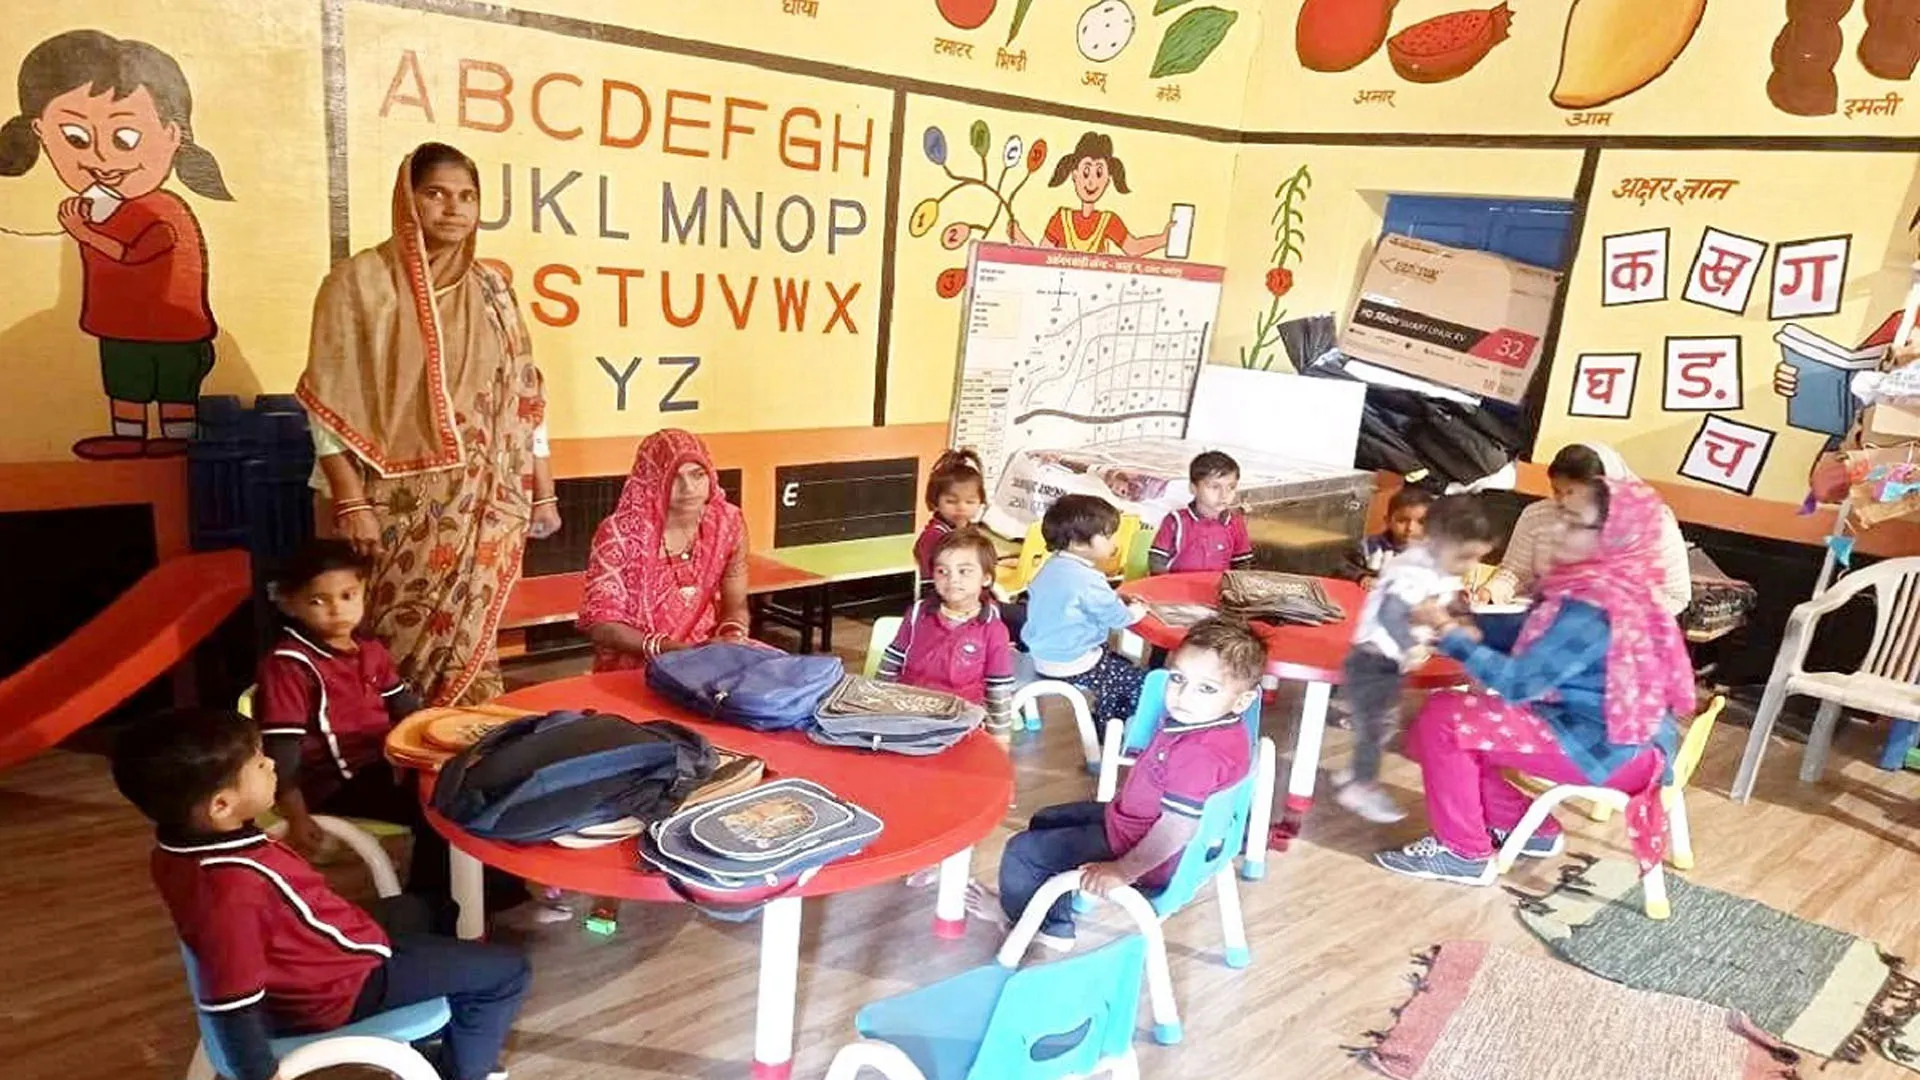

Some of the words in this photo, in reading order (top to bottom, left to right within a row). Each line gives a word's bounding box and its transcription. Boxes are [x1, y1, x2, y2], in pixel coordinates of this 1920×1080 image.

[934, 37, 975, 59] टमाटर
[1353, 89, 1396, 108] अनार
[1844, 92, 1904, 120] इमली
[1565, 112, 1613, 127] आम
[1006, 145, 1018, 160] C
[1612, 178, 1677, 206] अक्षर
[1673, 179, 1739, 205] ज्ञान
[948, 229, 958, 243] 2
[945, 275, 956, 291] 3
[1610, 249, 1659, 292] क
[1698, 245, 1752, 297] ख
[1778, 254, 1839, 302] ग
[1494, 336, 1525, 360] 32
[1584, 368, 1625, 404] घ
[1703, 427, 1756, 478] च
[782, 482, 799, 507] E
